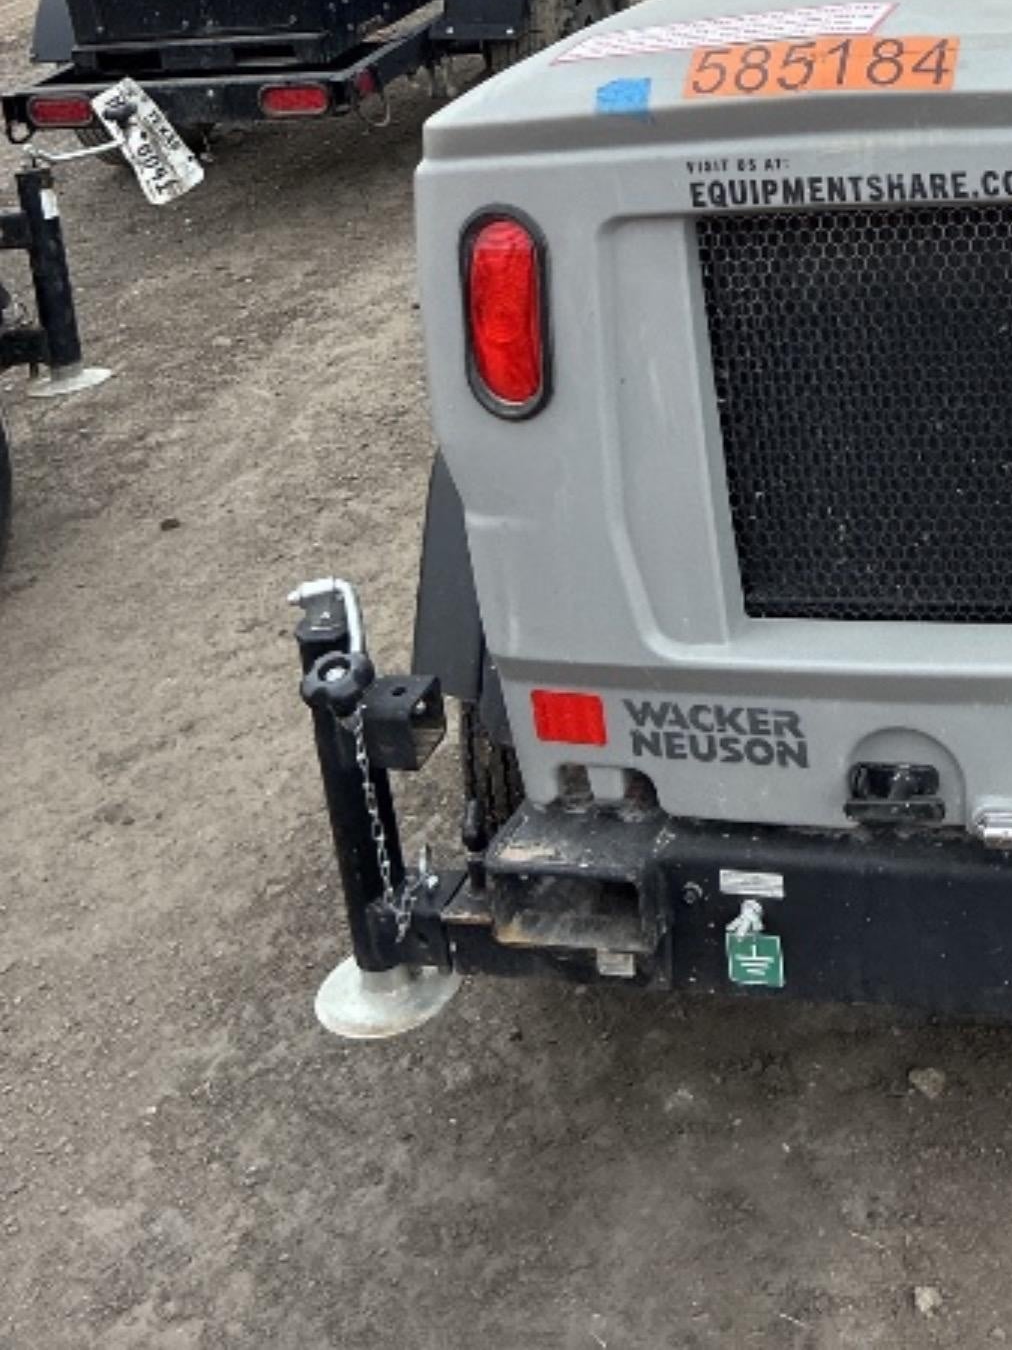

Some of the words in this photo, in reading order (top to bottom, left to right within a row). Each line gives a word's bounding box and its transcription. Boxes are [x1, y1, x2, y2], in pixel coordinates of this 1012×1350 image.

[692, 37, 951, 95] 585184
[685, 158, 728, 175] VISIT
[736, 157, 757, 172] US
[621, 699, 806, 739] WACKER
[630, 727, 810, 769] NEUSON
